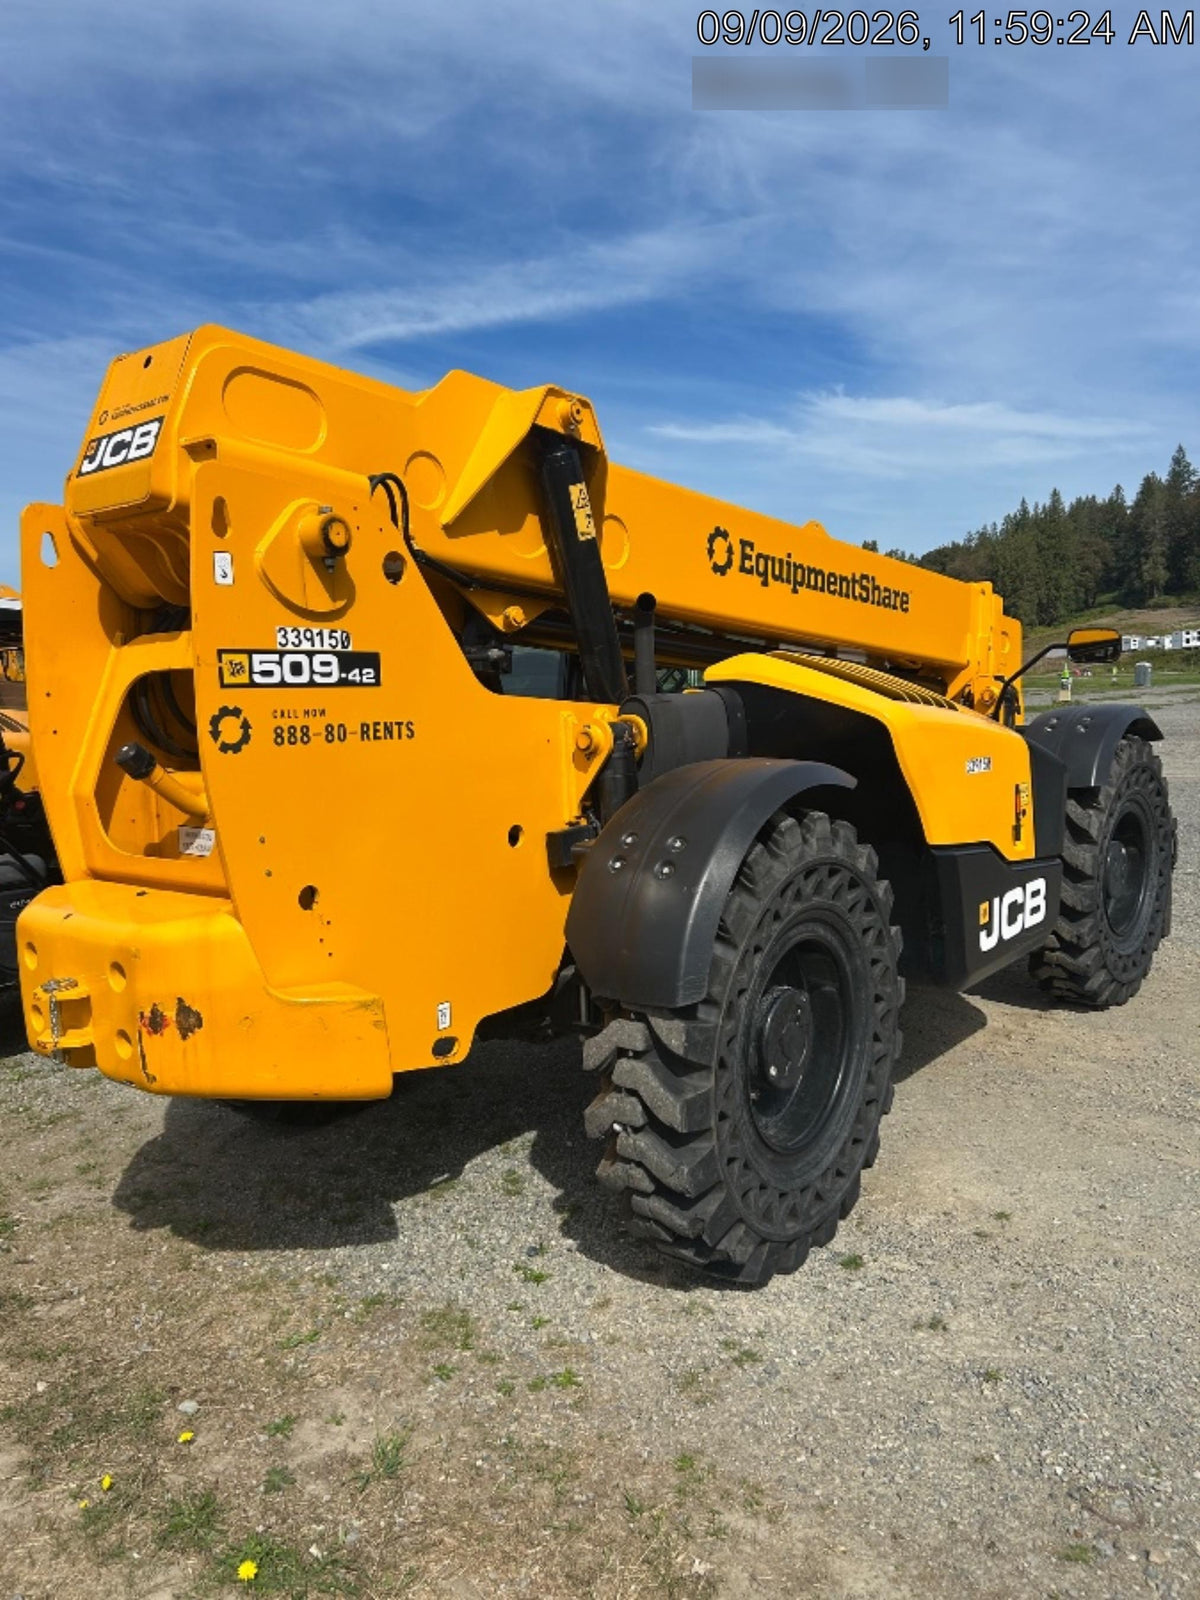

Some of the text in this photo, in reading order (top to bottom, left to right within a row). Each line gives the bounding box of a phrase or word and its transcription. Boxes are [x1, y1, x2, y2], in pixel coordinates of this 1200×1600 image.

[80, 419, 160, 473] JCB
[738, 538, 910, 614] EquipmentShare
[276, 627, 351, 650] 339150
[272, 709, 326, 719] CALL NOW
[273, 721, 415, 747] 888-80-RENTS
[979, 877, 1047, 952] JCB
